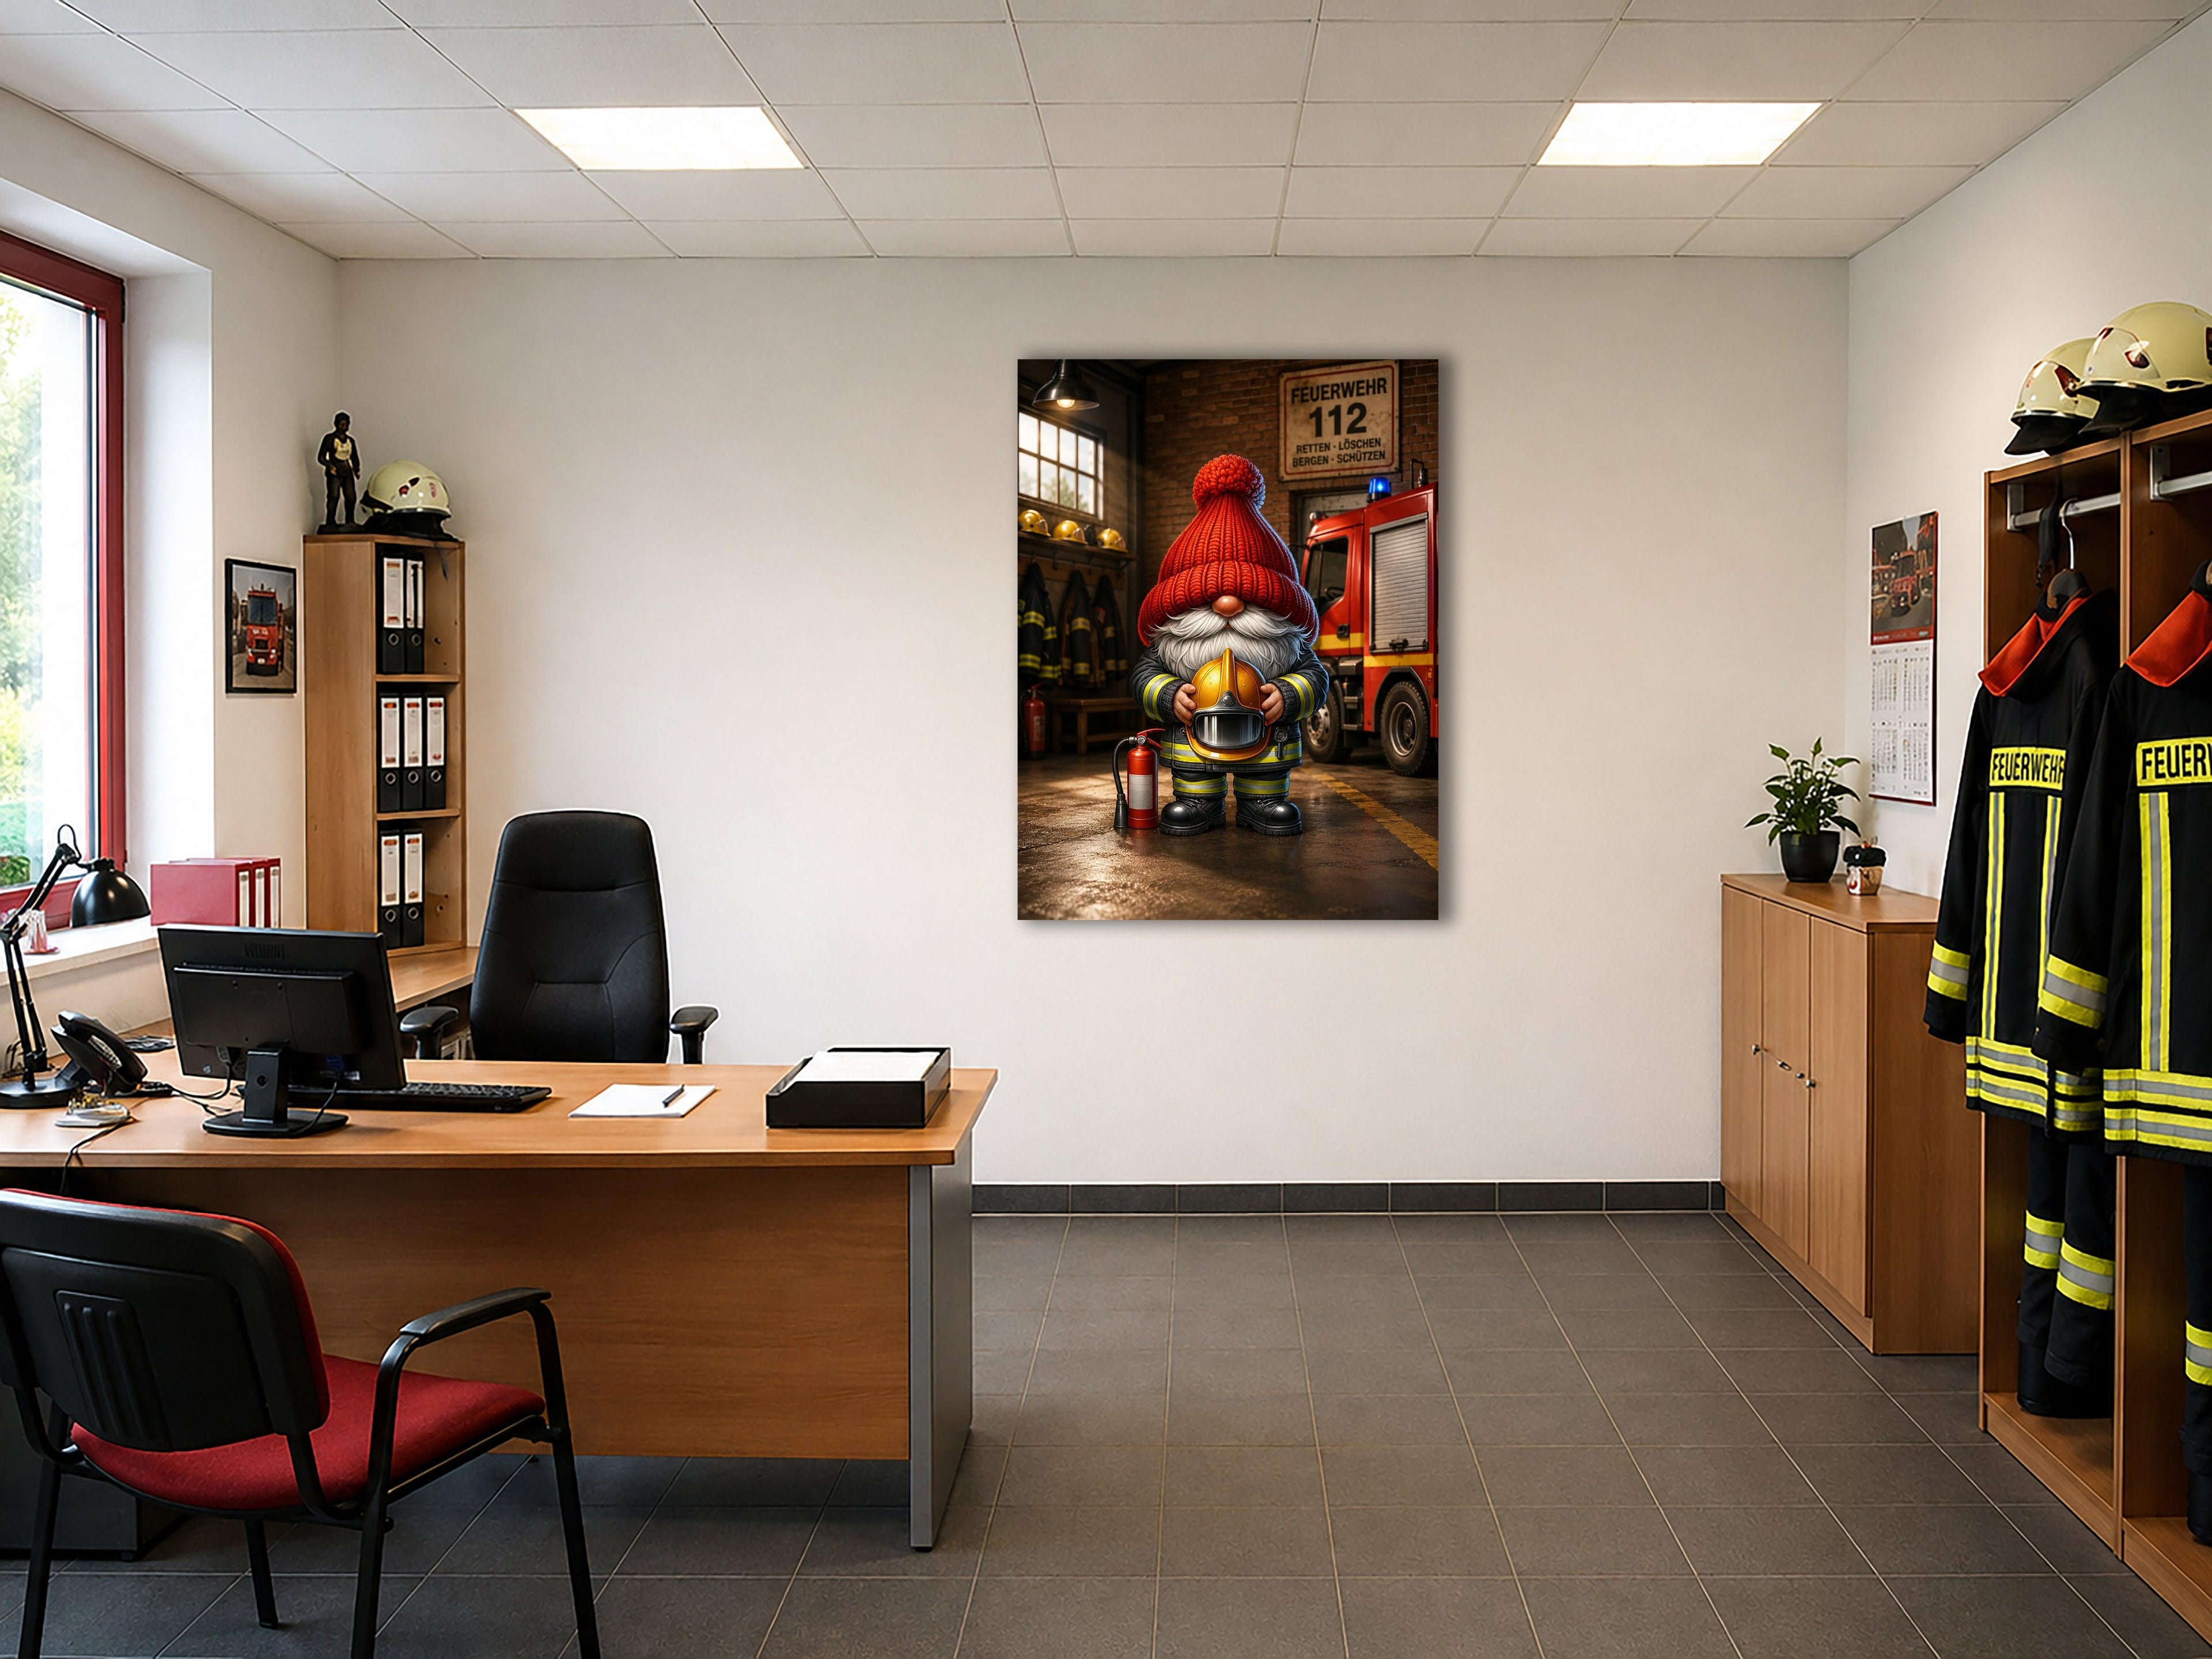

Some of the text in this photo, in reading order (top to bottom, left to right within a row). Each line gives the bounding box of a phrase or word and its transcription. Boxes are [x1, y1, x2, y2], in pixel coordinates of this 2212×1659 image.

[1291, 378, 1388, 404] FEUERWEHR
[1309, 403, 1368, 437] 112
[1293, 450, 1386, 467] BERGEN SCHÜTZEN
[1296, 438, 1381, 454] RETTEN LÖSCHEN
[2142, 743, 2212, 780] FEUER
